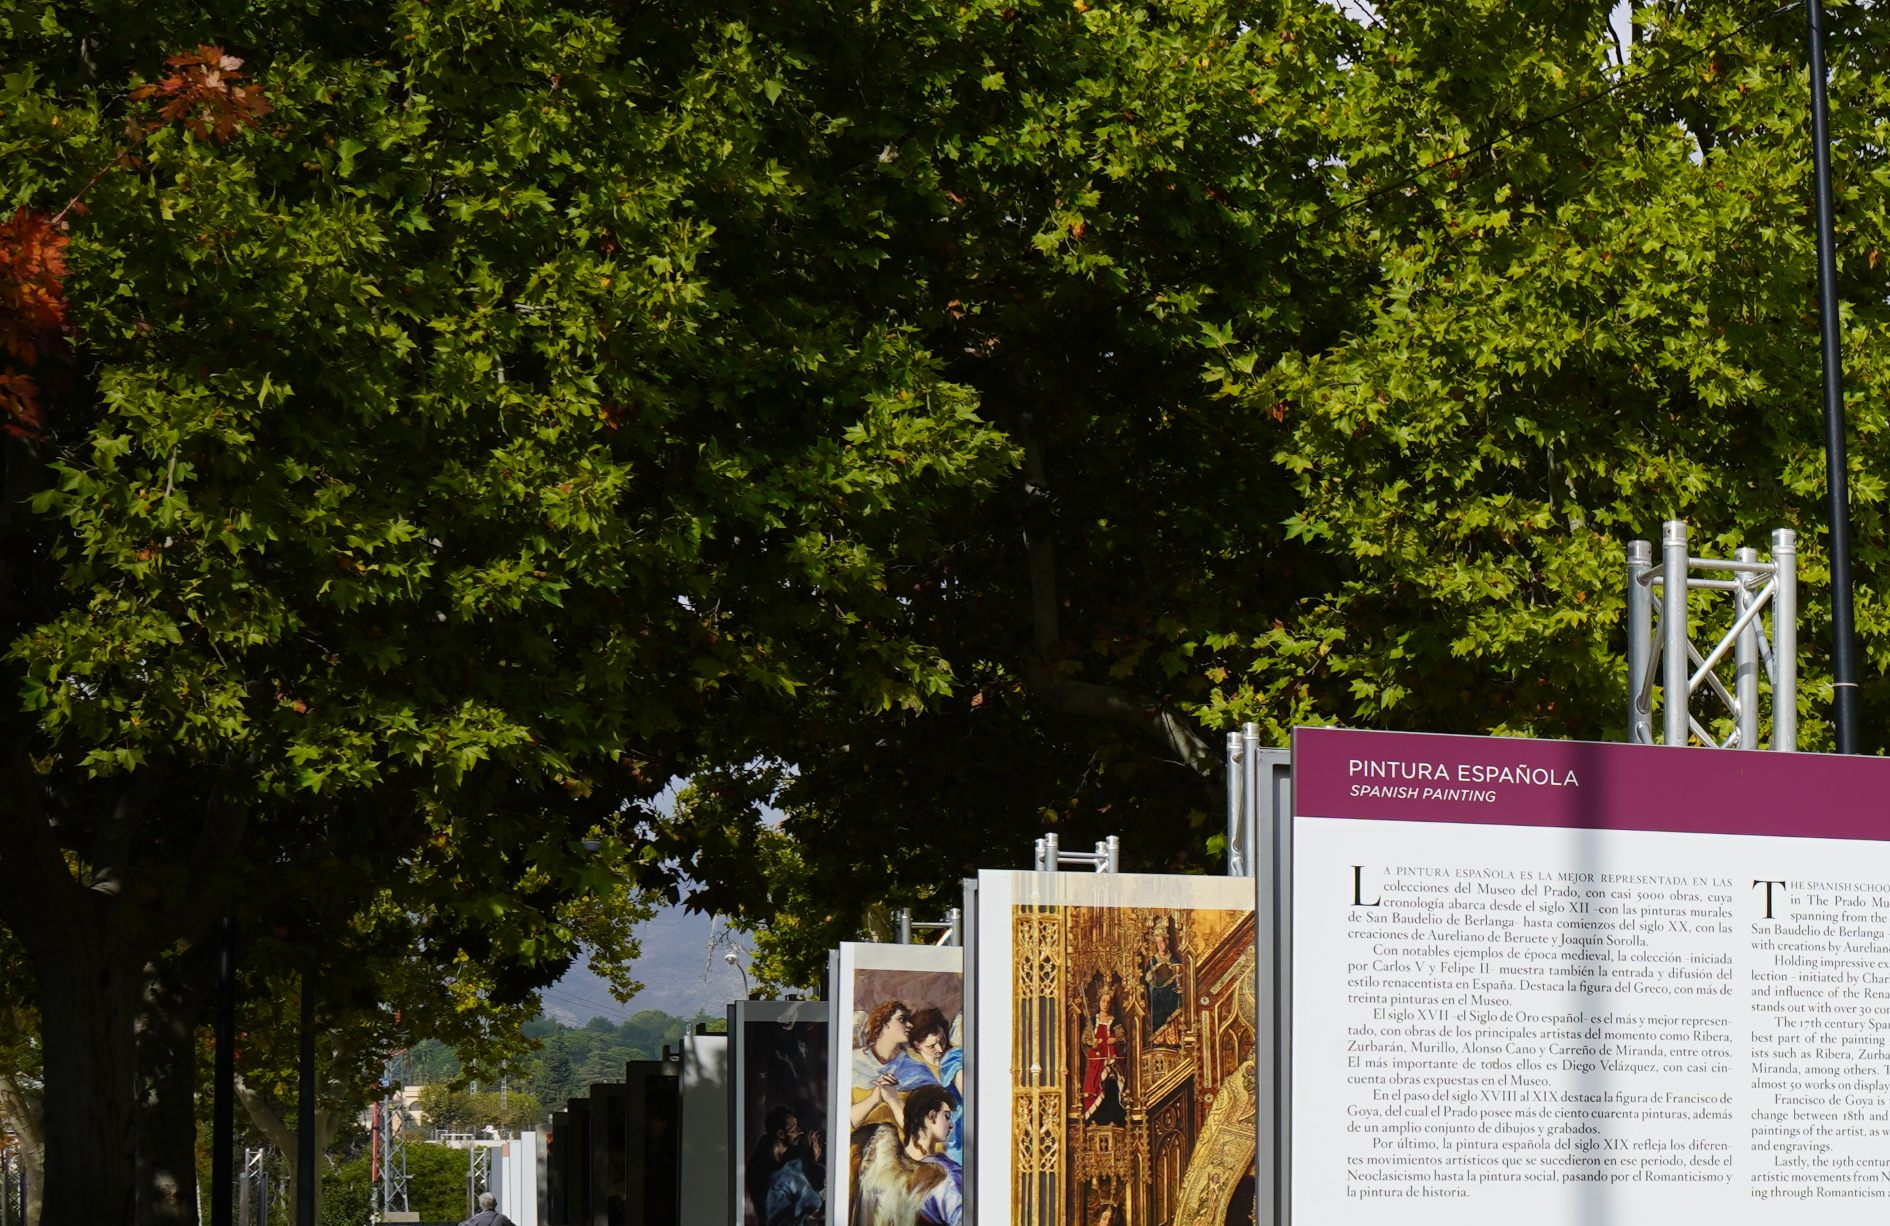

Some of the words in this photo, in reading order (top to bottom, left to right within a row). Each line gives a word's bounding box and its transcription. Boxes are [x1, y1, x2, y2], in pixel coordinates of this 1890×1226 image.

[1349, 759, 1450, 781] PINTURA
[1458, 764, 1579, 786] ESPAÑOLA
[1350, 785, 1419, 799] SPANISH
[1422, 788, 1496, 802] PAINTING
[1383, 881, 1449, 894] colecciones
[1454, 883, 1471, 894] del
[1477, 883, 1515, 896] Museo
[1520, 884, 1537, 896] del
[1585, 889, 1605, 898] con
[1610, 887, 1631, 899] casi
[1707, 893, 1732, 905] cuya
[1347, 912, 1362, 923] de
[1366, 912, 1387, 924] San
[1392, 913, 1442, 925] Baudelio
[1446, 914, 1460, 926] de
[1523, 916, 1552, 928] hasta
[1556, 917, 1615, 930] comienzos
[1618, 918, 1635, 930] del
[1639, 919, 1664, 934] siglo
[1695, 923, 1714, 932] con
[1718, 921, 1732, 933] las
[1347, 928, 1408, 941] creaciones
[1411, 929, 1425, 941] de
[1427, 930, 1484, 942] Aureliano
[1487, 931, 1501, 943] de
[1504, 931, 1548, 944] Beruete
[1551, 935, 1557, 947] y
[1558, 933, 1603, 948] Joaquín
[1348, 992, 1387, 1004] treinta
[1390, 993, 1438, 1008] pinturas
[1441, 996, 1455, 1005] en
[1457, 994, 1467, 1005] el
[1751, 1000, 1785, 1013] stands
[1787, 1001, 1805, 1013] out
[1807, 1001, 1831, 1013] with
[1833, 1005, 1857, 1014] over
[1461, 1041, 1502, 1053] Alonso
[1505, 1042, 1536, 1054] Cano
[1539, 1046, 1545, 1057] y
[1548, 1043, 1596, 1055] Carreño
[1598, 1043, 1612, 1055] de
[1669, 1045, 1698, 1056] entre
[1804, 1066, 1840, 1078] among
[1775, 1093, 1825, 1105] Francisco
[1828, 1094, 1841, 1105] de
[1844, 1094, 1873, 1109] Goya
[1877, 1094, 1885, 1106] is
[1750, 1109, 1788, 1124] change
[1793, 1109, 1837, 1121] between
[1869, 1110, 1888, 1121] and
[1751, 1140, 1770, 1151] and
[1347, 1168, 1431, 1180] Neoclasicismo
[1434, 1168, 1463, 1180] hasta
[1467, 1168, 1476, 1180] la
[1479, 1169, 1521, 1183] pintura
[1562, 1169, 1608, 1184] pasando
[1610, 1172, 1629, 1184] por
[1632, 1169, 1641, 1180] el
[1645, 1169, 1723, 1181] Romanticismo
[1726, 1172, 1732, 1184] y
[1347, 1184, 1356, 1196] la
[1359, 1184, 1403, 1199] pintura
[1405, 1184, 1419, 1196] de
[1751, 1186, 1768, 1201] ing
[1770, 1186, 1813, 1201] through
[1816, 1186, 1885, 1198] Romanticism
